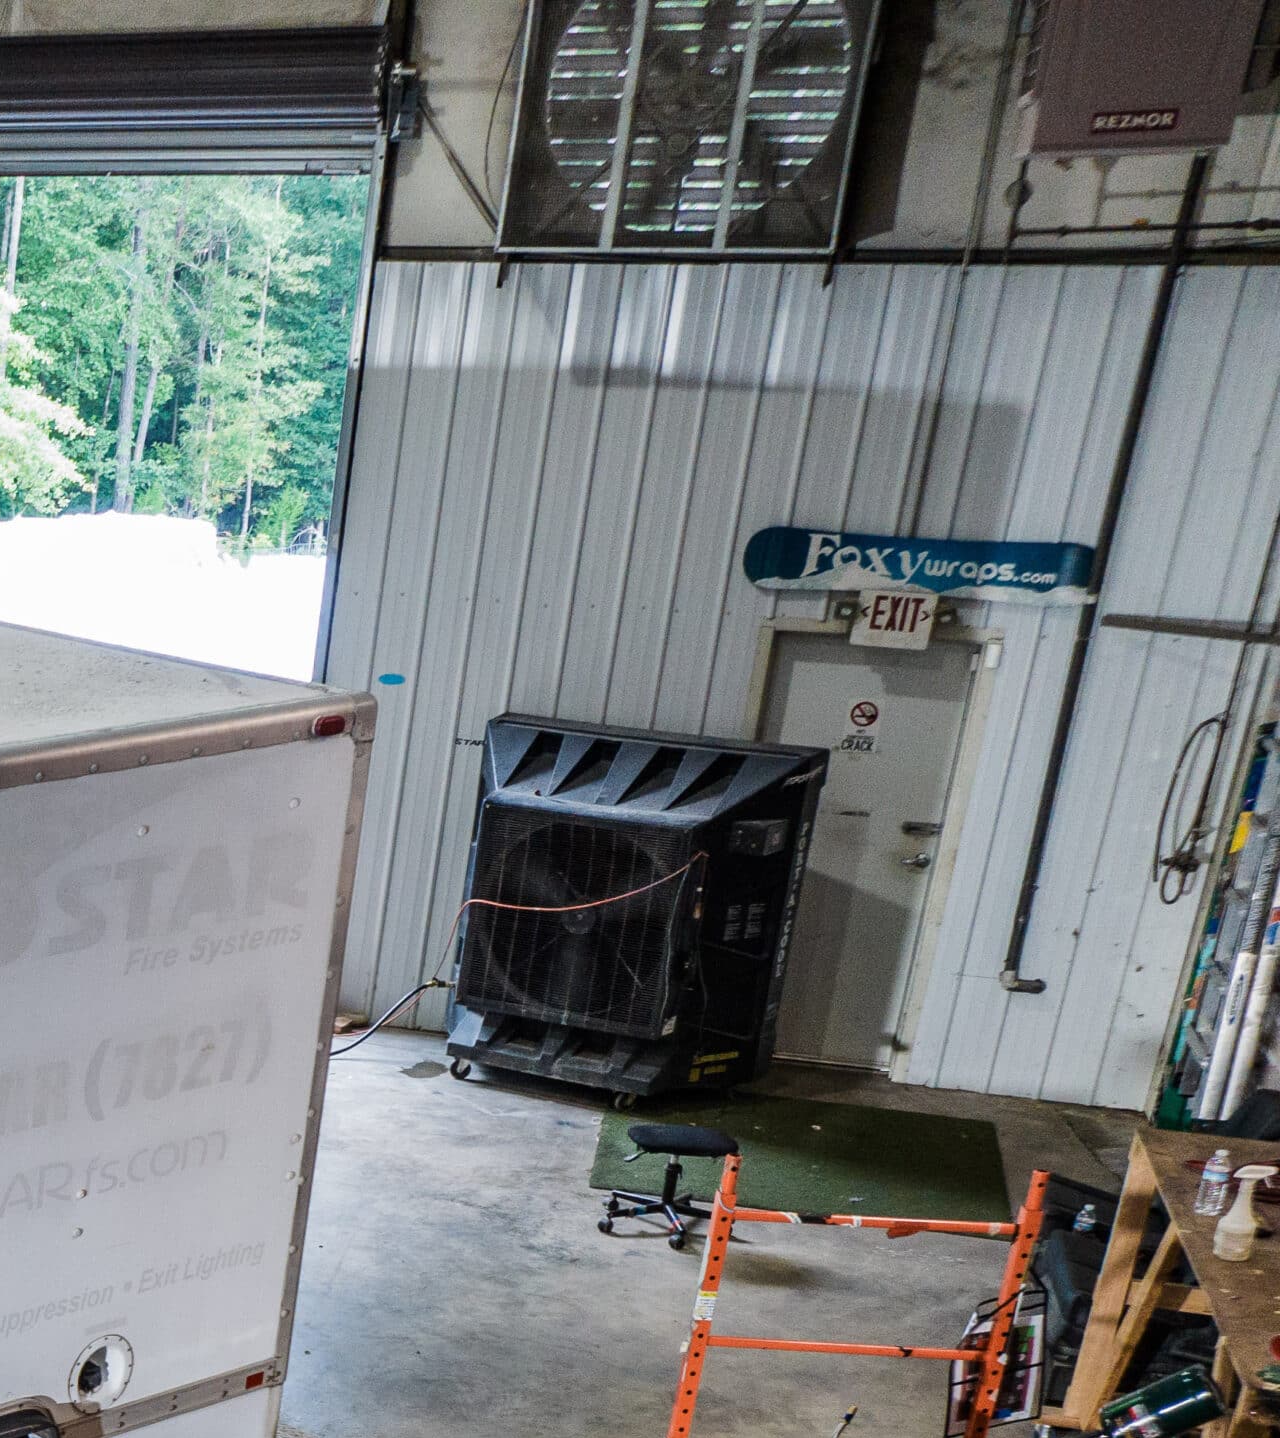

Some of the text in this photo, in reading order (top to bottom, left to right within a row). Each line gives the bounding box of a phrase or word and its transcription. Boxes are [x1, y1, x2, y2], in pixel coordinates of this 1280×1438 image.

[869, 595, 925, 633] EXIT
[124, 919, 303, 977] Fire Systems
[83, 1008, 272, 1122] (7827)
[137, 1266, 179, 1295] Exit
[182, 1239, 267, 1283] Lighting
